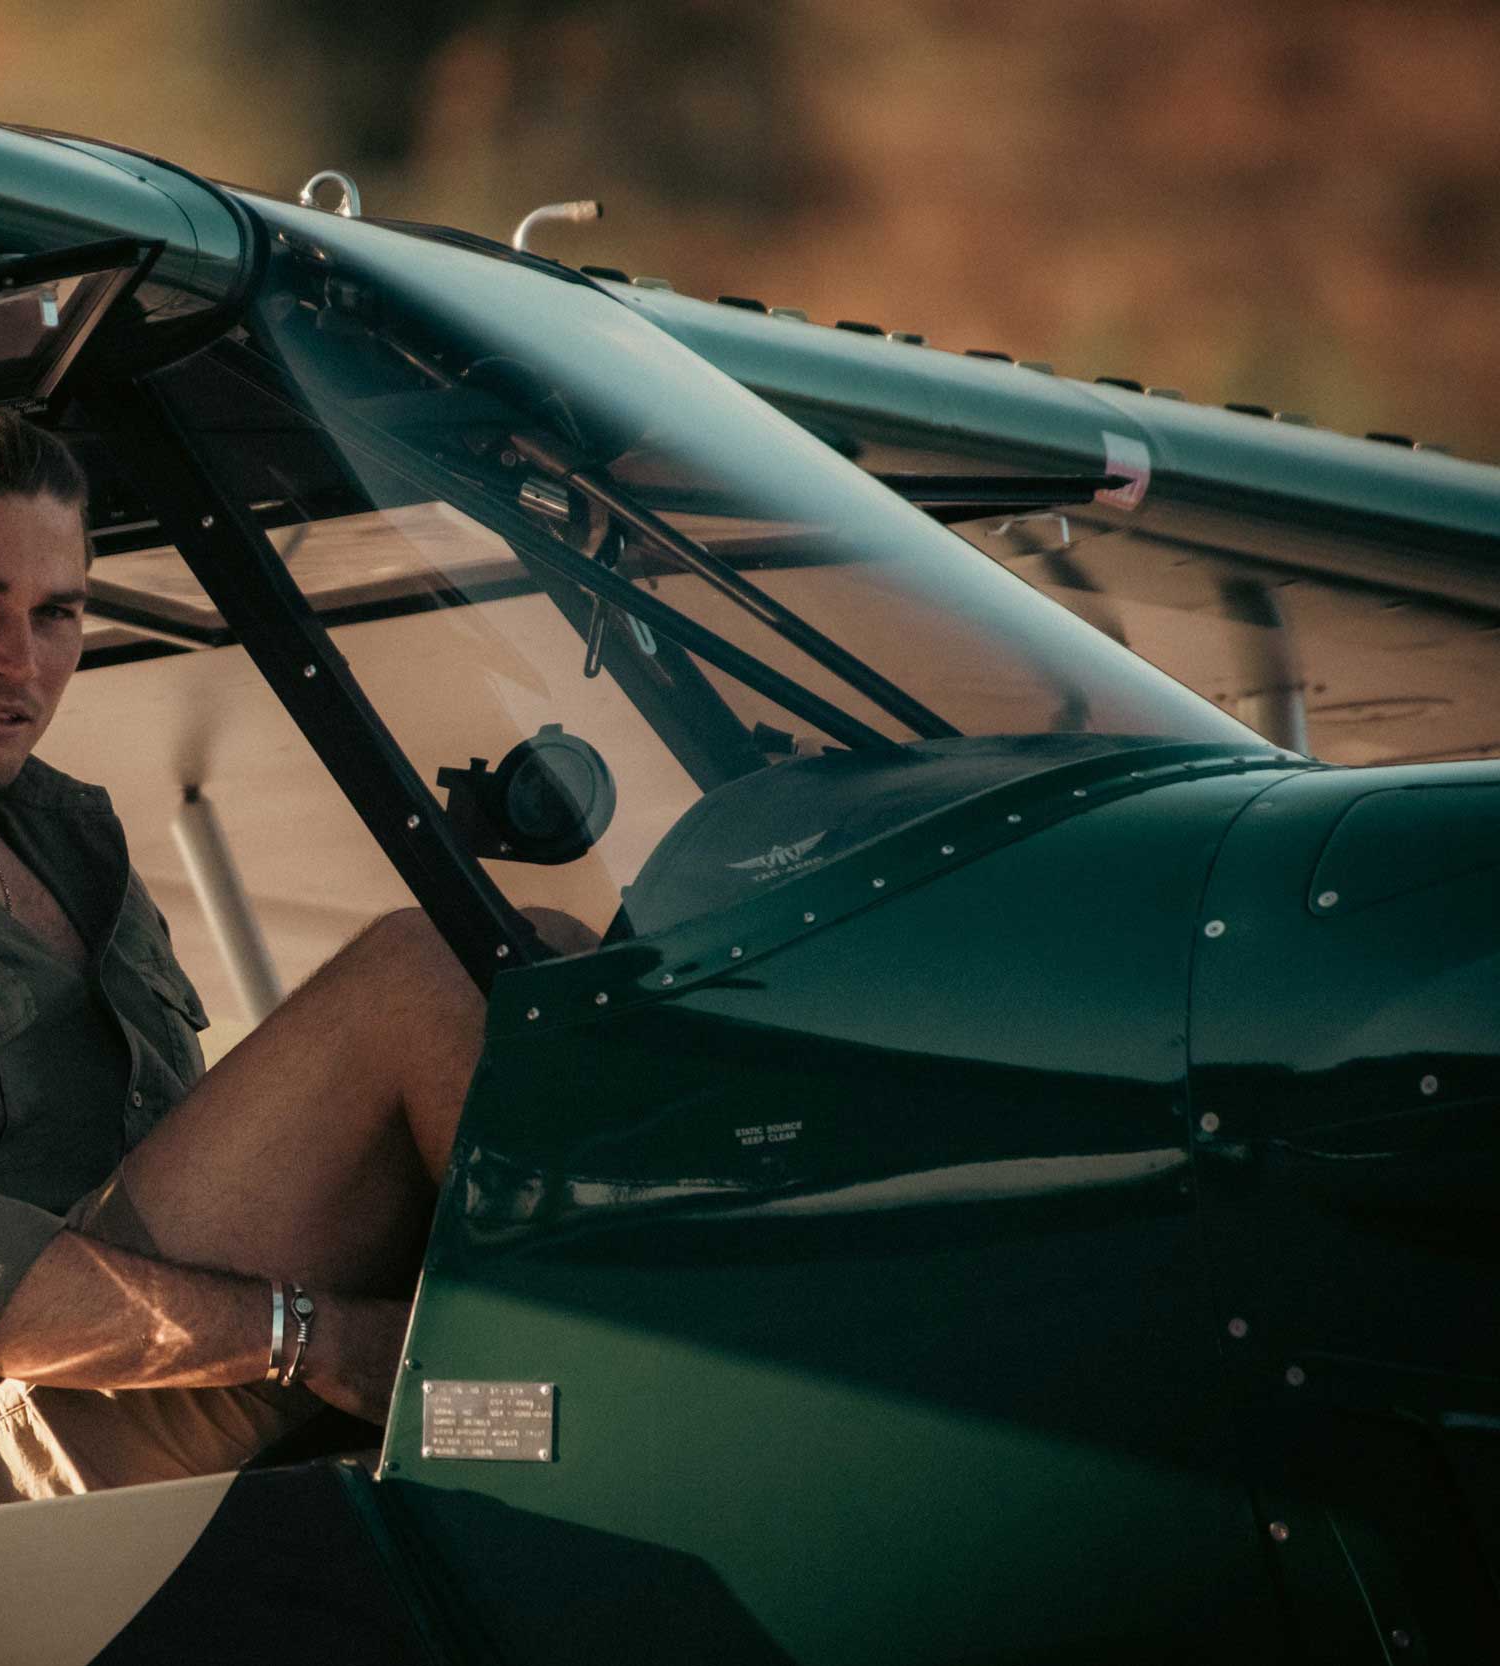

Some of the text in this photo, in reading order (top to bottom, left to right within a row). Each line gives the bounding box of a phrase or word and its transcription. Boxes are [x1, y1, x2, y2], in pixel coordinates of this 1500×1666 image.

[735, 1121, 802, 1137] STATIC SOURCE
[741, 1131, 796, 1145] KEEP CLEAR
